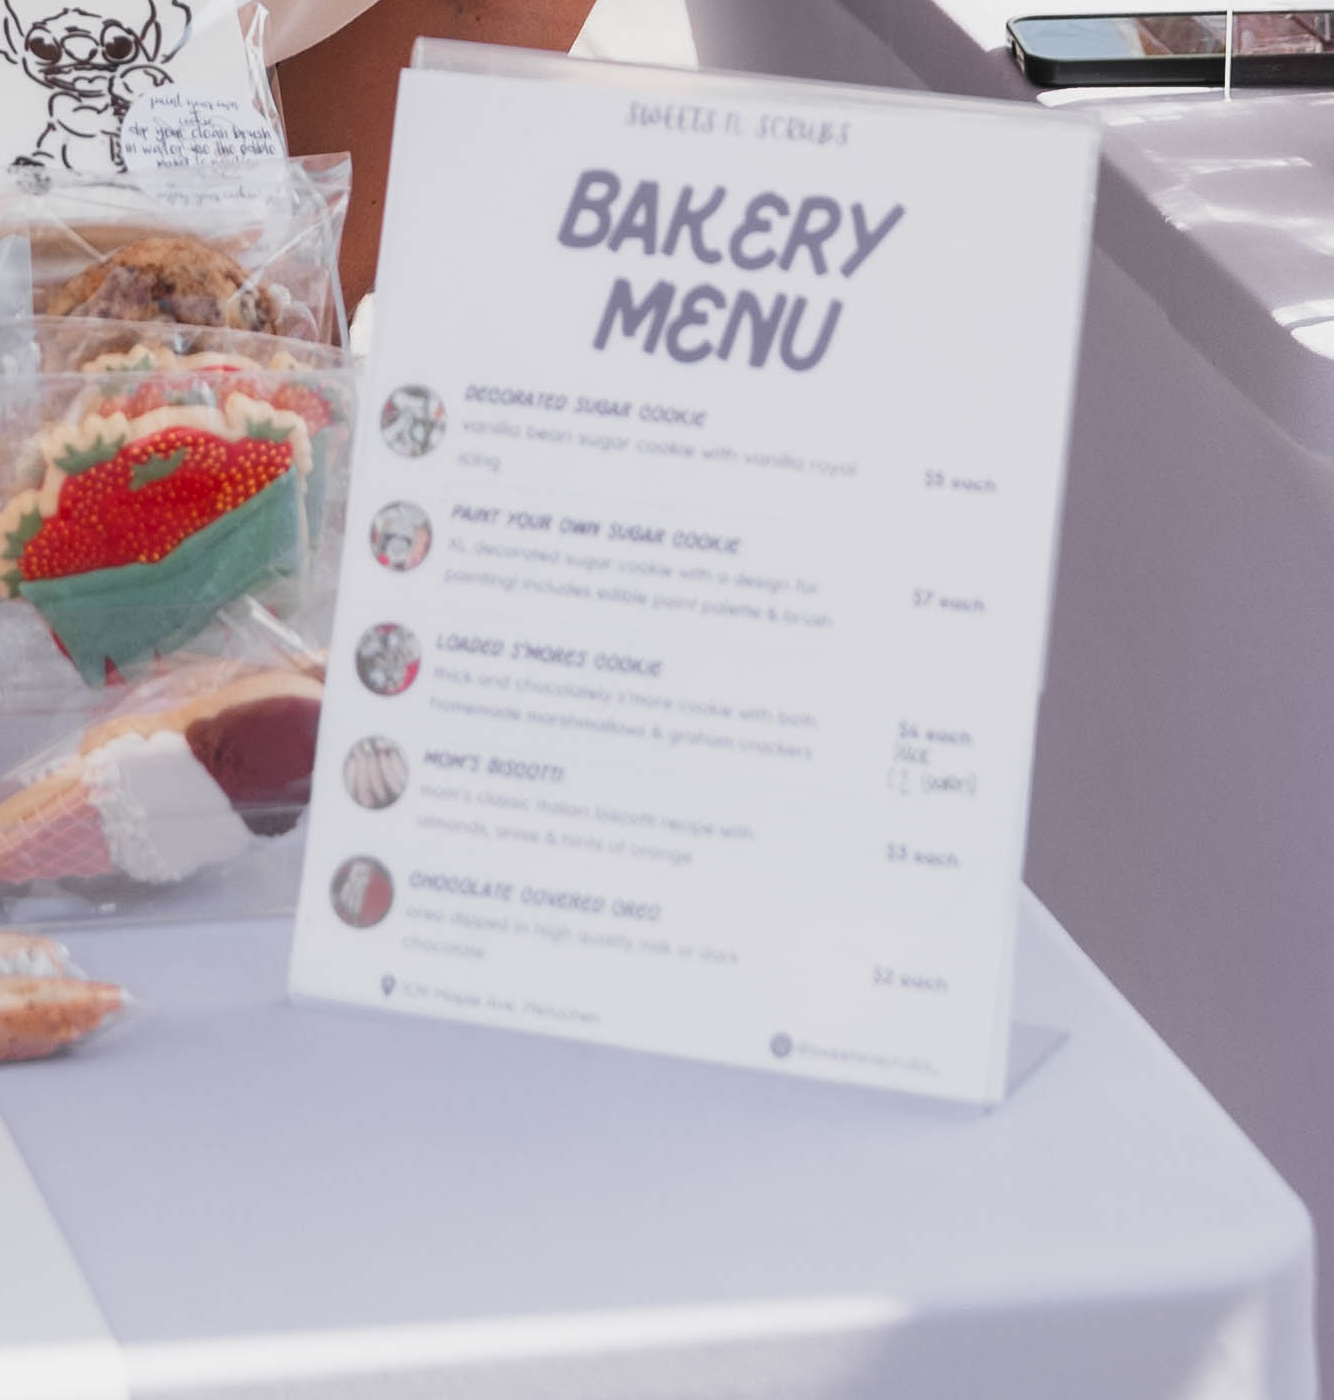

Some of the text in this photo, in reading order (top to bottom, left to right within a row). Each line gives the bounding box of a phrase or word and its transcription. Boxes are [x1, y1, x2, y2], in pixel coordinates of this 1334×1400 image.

[557, 168, 906, 279] BAKERY
[591, 278, 844, 372] MENU
[465, 384, 707, 427] DECORATED SUGAR COOKIE
[451, 503, 741, 554] PAINT YOUR OWN SUGAR COOKIE
[435, 633, 505, 656] LOADED
[594, 653, 664, 676] COOKIE
[487, 756, 565, 783] BISCOTTI
[410, 870, 662, 921] CHOCOLATE COVERED OREO
